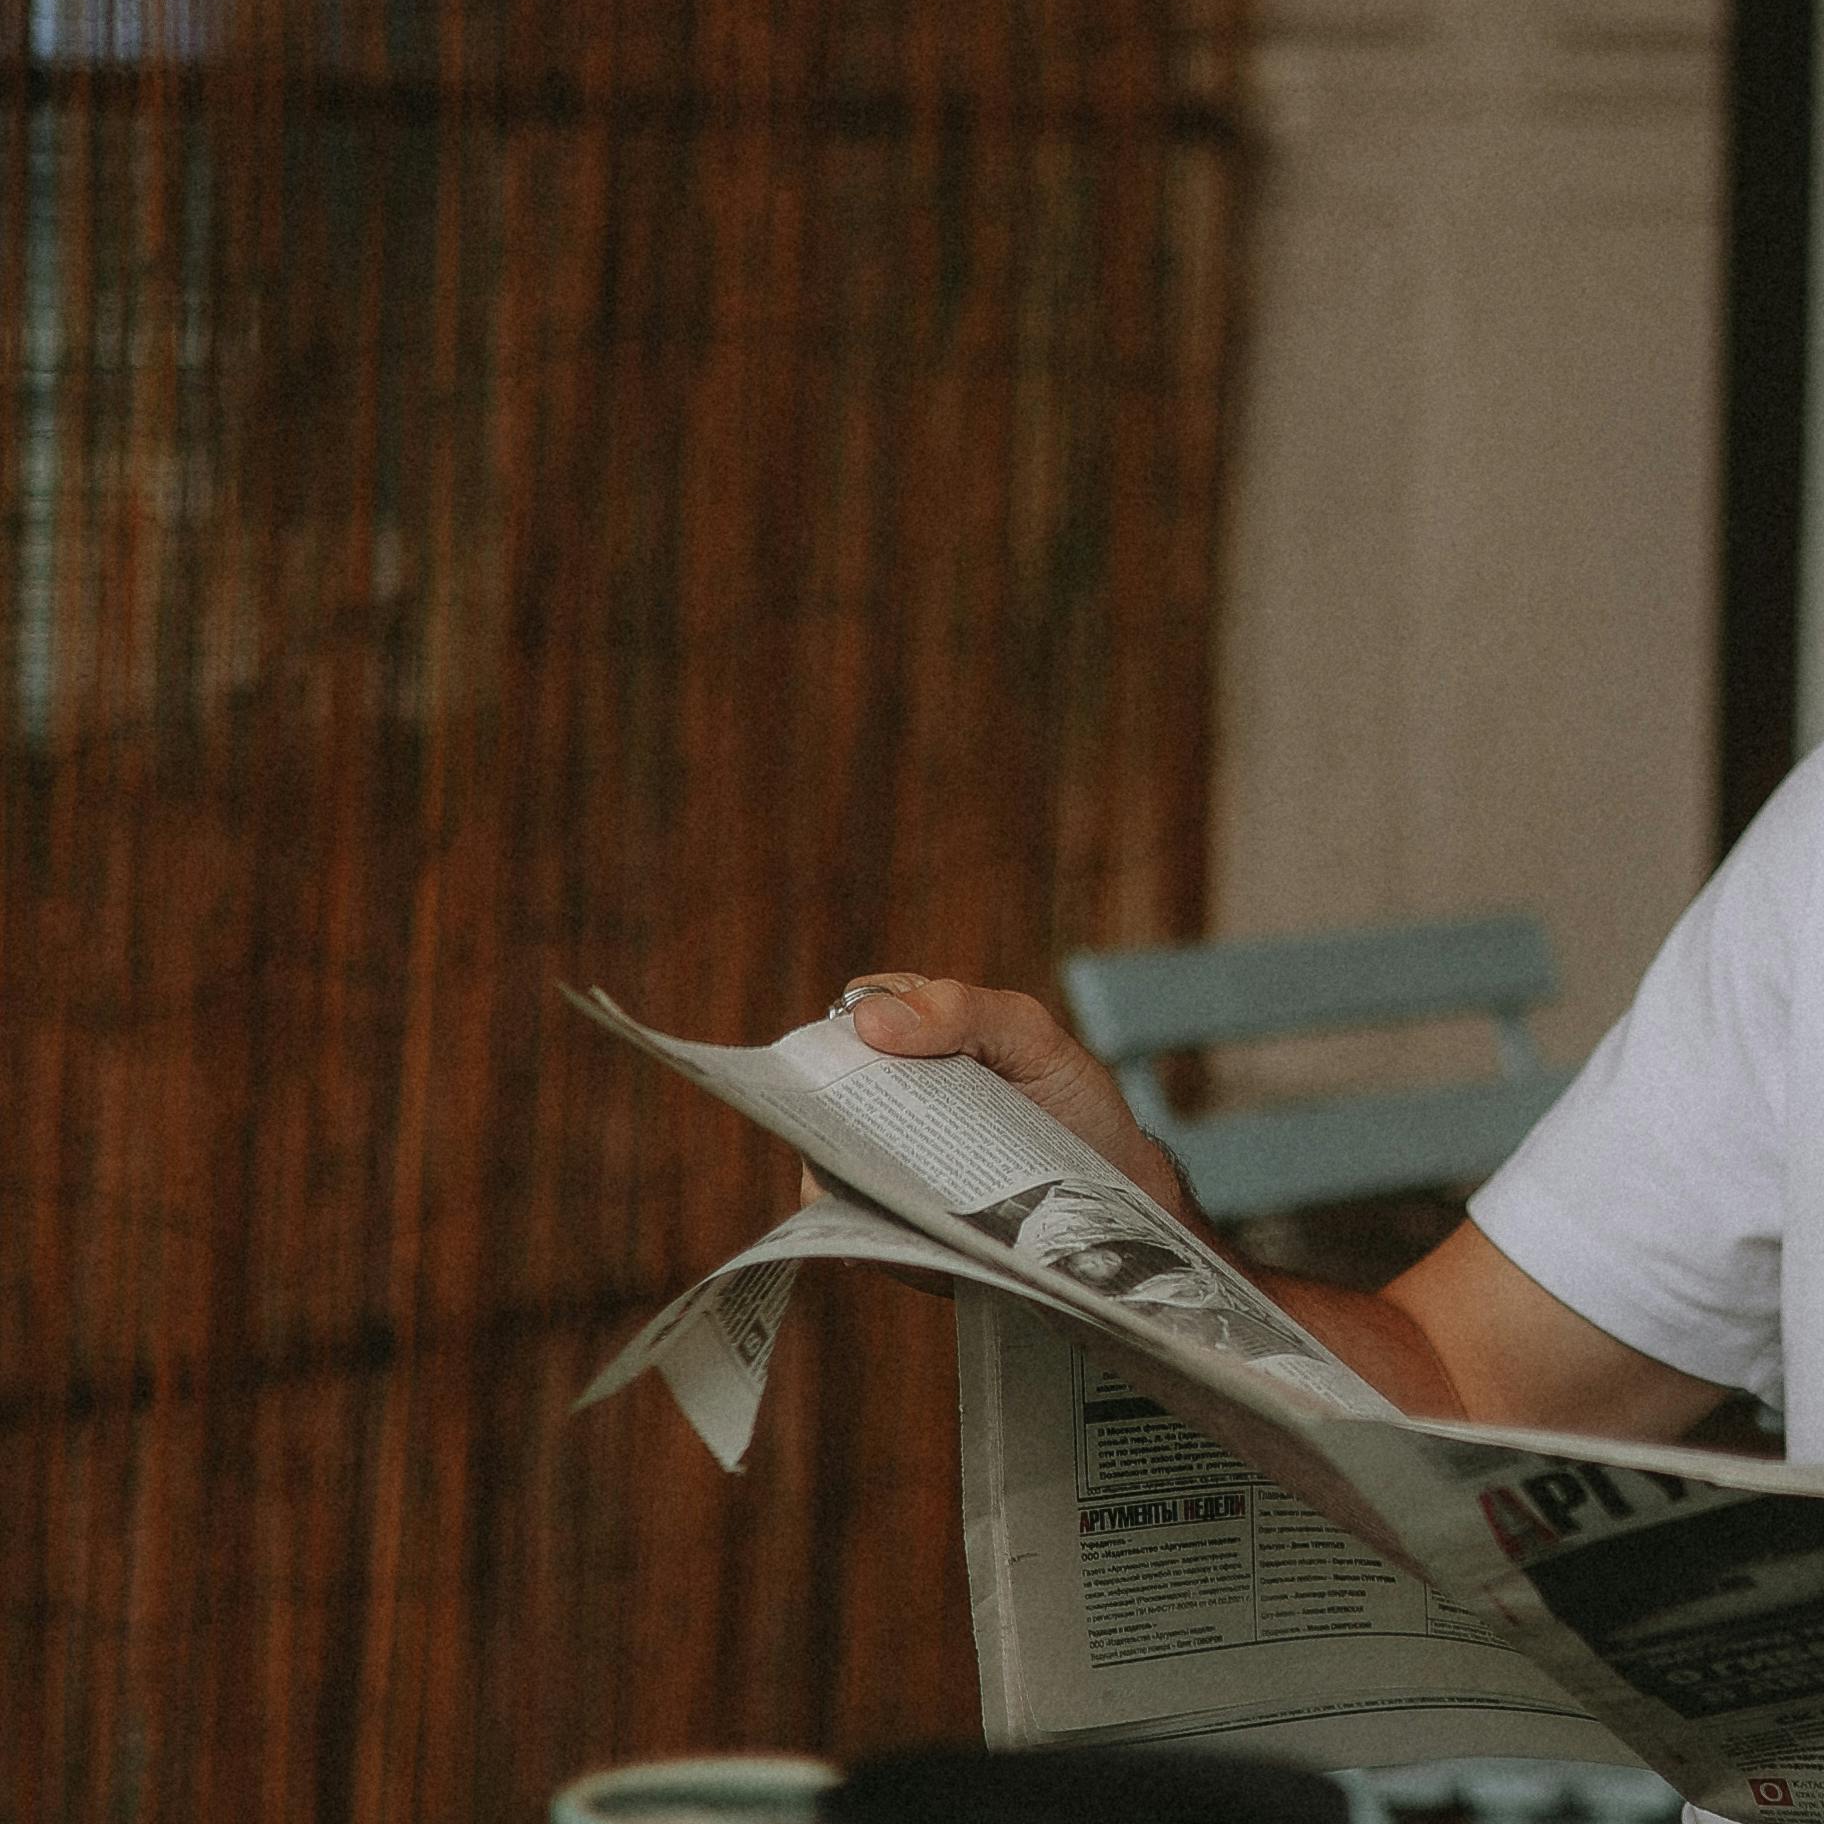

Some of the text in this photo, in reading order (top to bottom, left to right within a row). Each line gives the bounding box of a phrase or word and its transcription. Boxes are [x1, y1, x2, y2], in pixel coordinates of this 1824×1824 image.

[1080, 1495, 1245, 1533] АРГУМЕНТЫ НЕДЕЛИ
[1081, 1552, 1100, 1562] ООО
